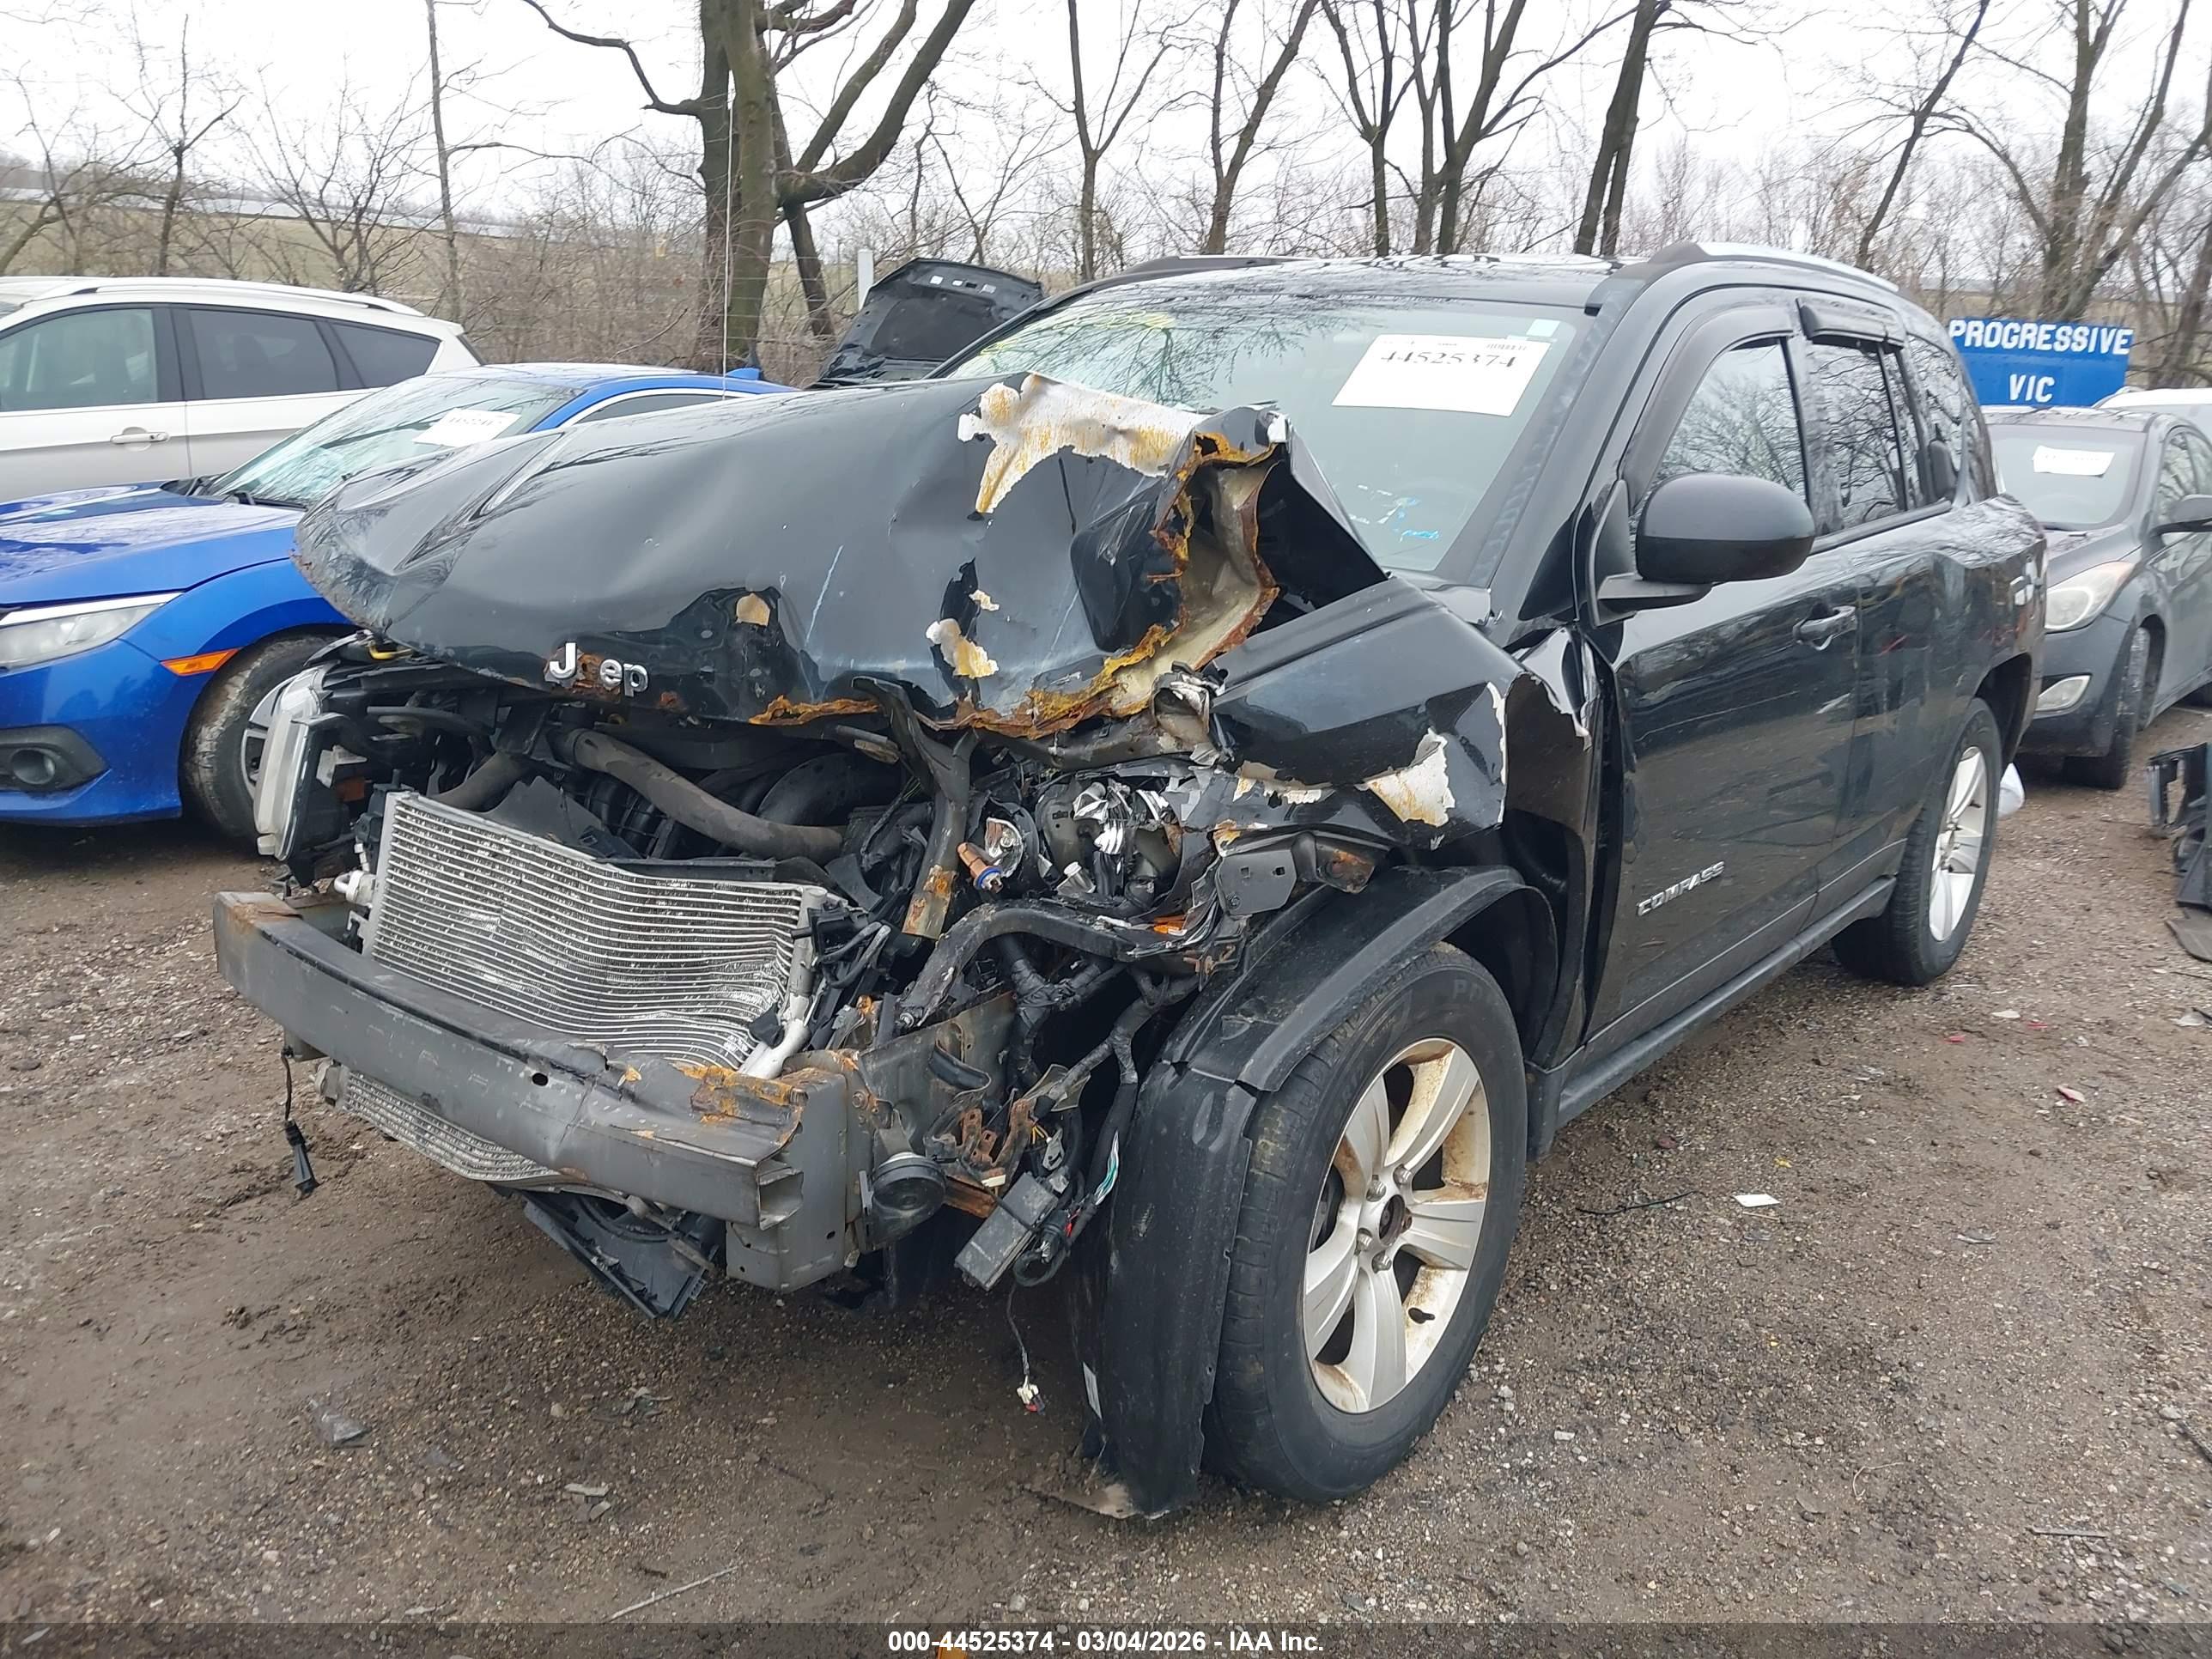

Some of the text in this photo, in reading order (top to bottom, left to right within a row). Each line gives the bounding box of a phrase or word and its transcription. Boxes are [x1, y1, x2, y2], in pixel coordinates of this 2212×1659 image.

[1948, 319, 2134, 356] PROGRESSIVE
[1381, 350, 1516, 368] 44525374
[2008, 374, 2055, 403] VIC
[549, 641, 649, 697] Jep
[1637, 860, 1725, 916] COMPASS
